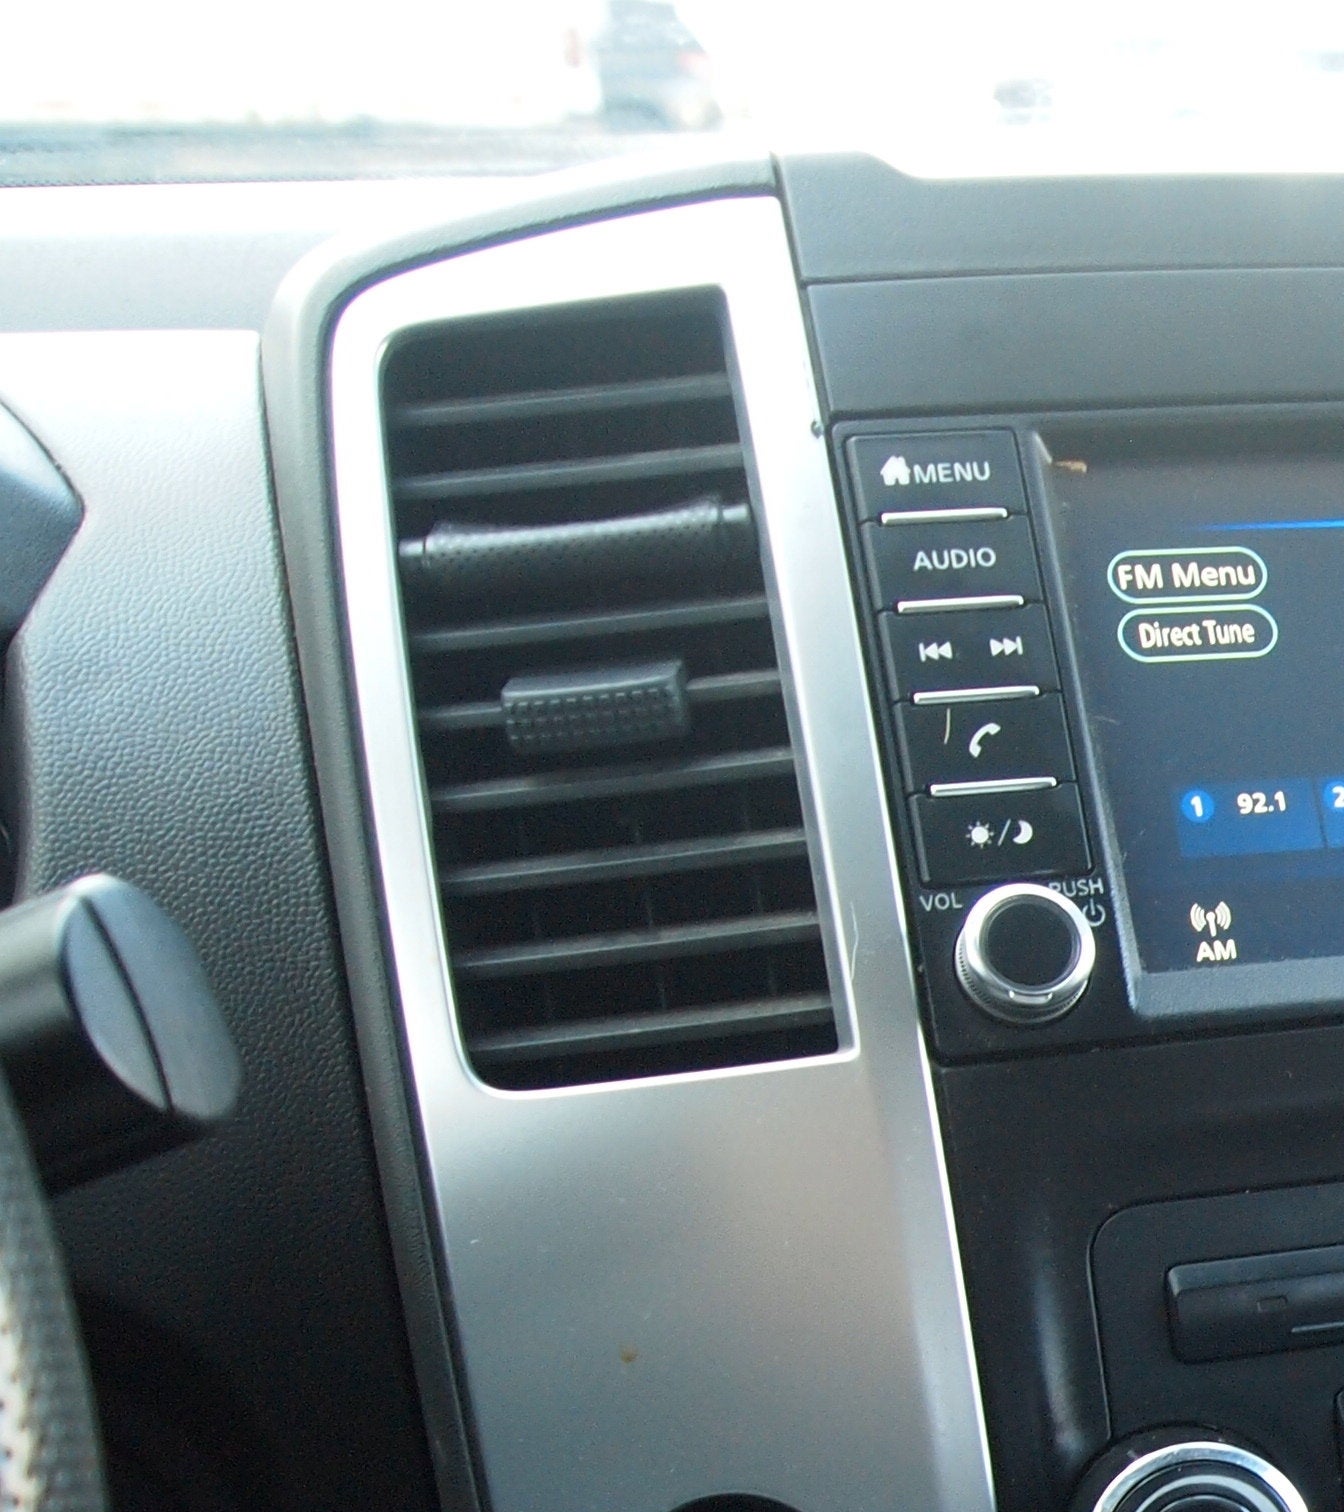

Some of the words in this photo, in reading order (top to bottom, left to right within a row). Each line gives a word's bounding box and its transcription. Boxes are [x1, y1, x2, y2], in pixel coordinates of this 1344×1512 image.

[913, 460, 991, 485] MENU
[912, 546, 997, 571] AUDIO
[1116, 563, 1164, 590] FM
[1171, 561, 1257, 588] Menu
[1137, 620, 1203, 649] Direct
[1202, 618, 1256, 646] Tune
[1189, 795, 1206, 818] 1
[1236, 790, 1287, 816] 92.1
[919, 891, 964, 914] VOL
[1195, 937, 1238, 962] AM
